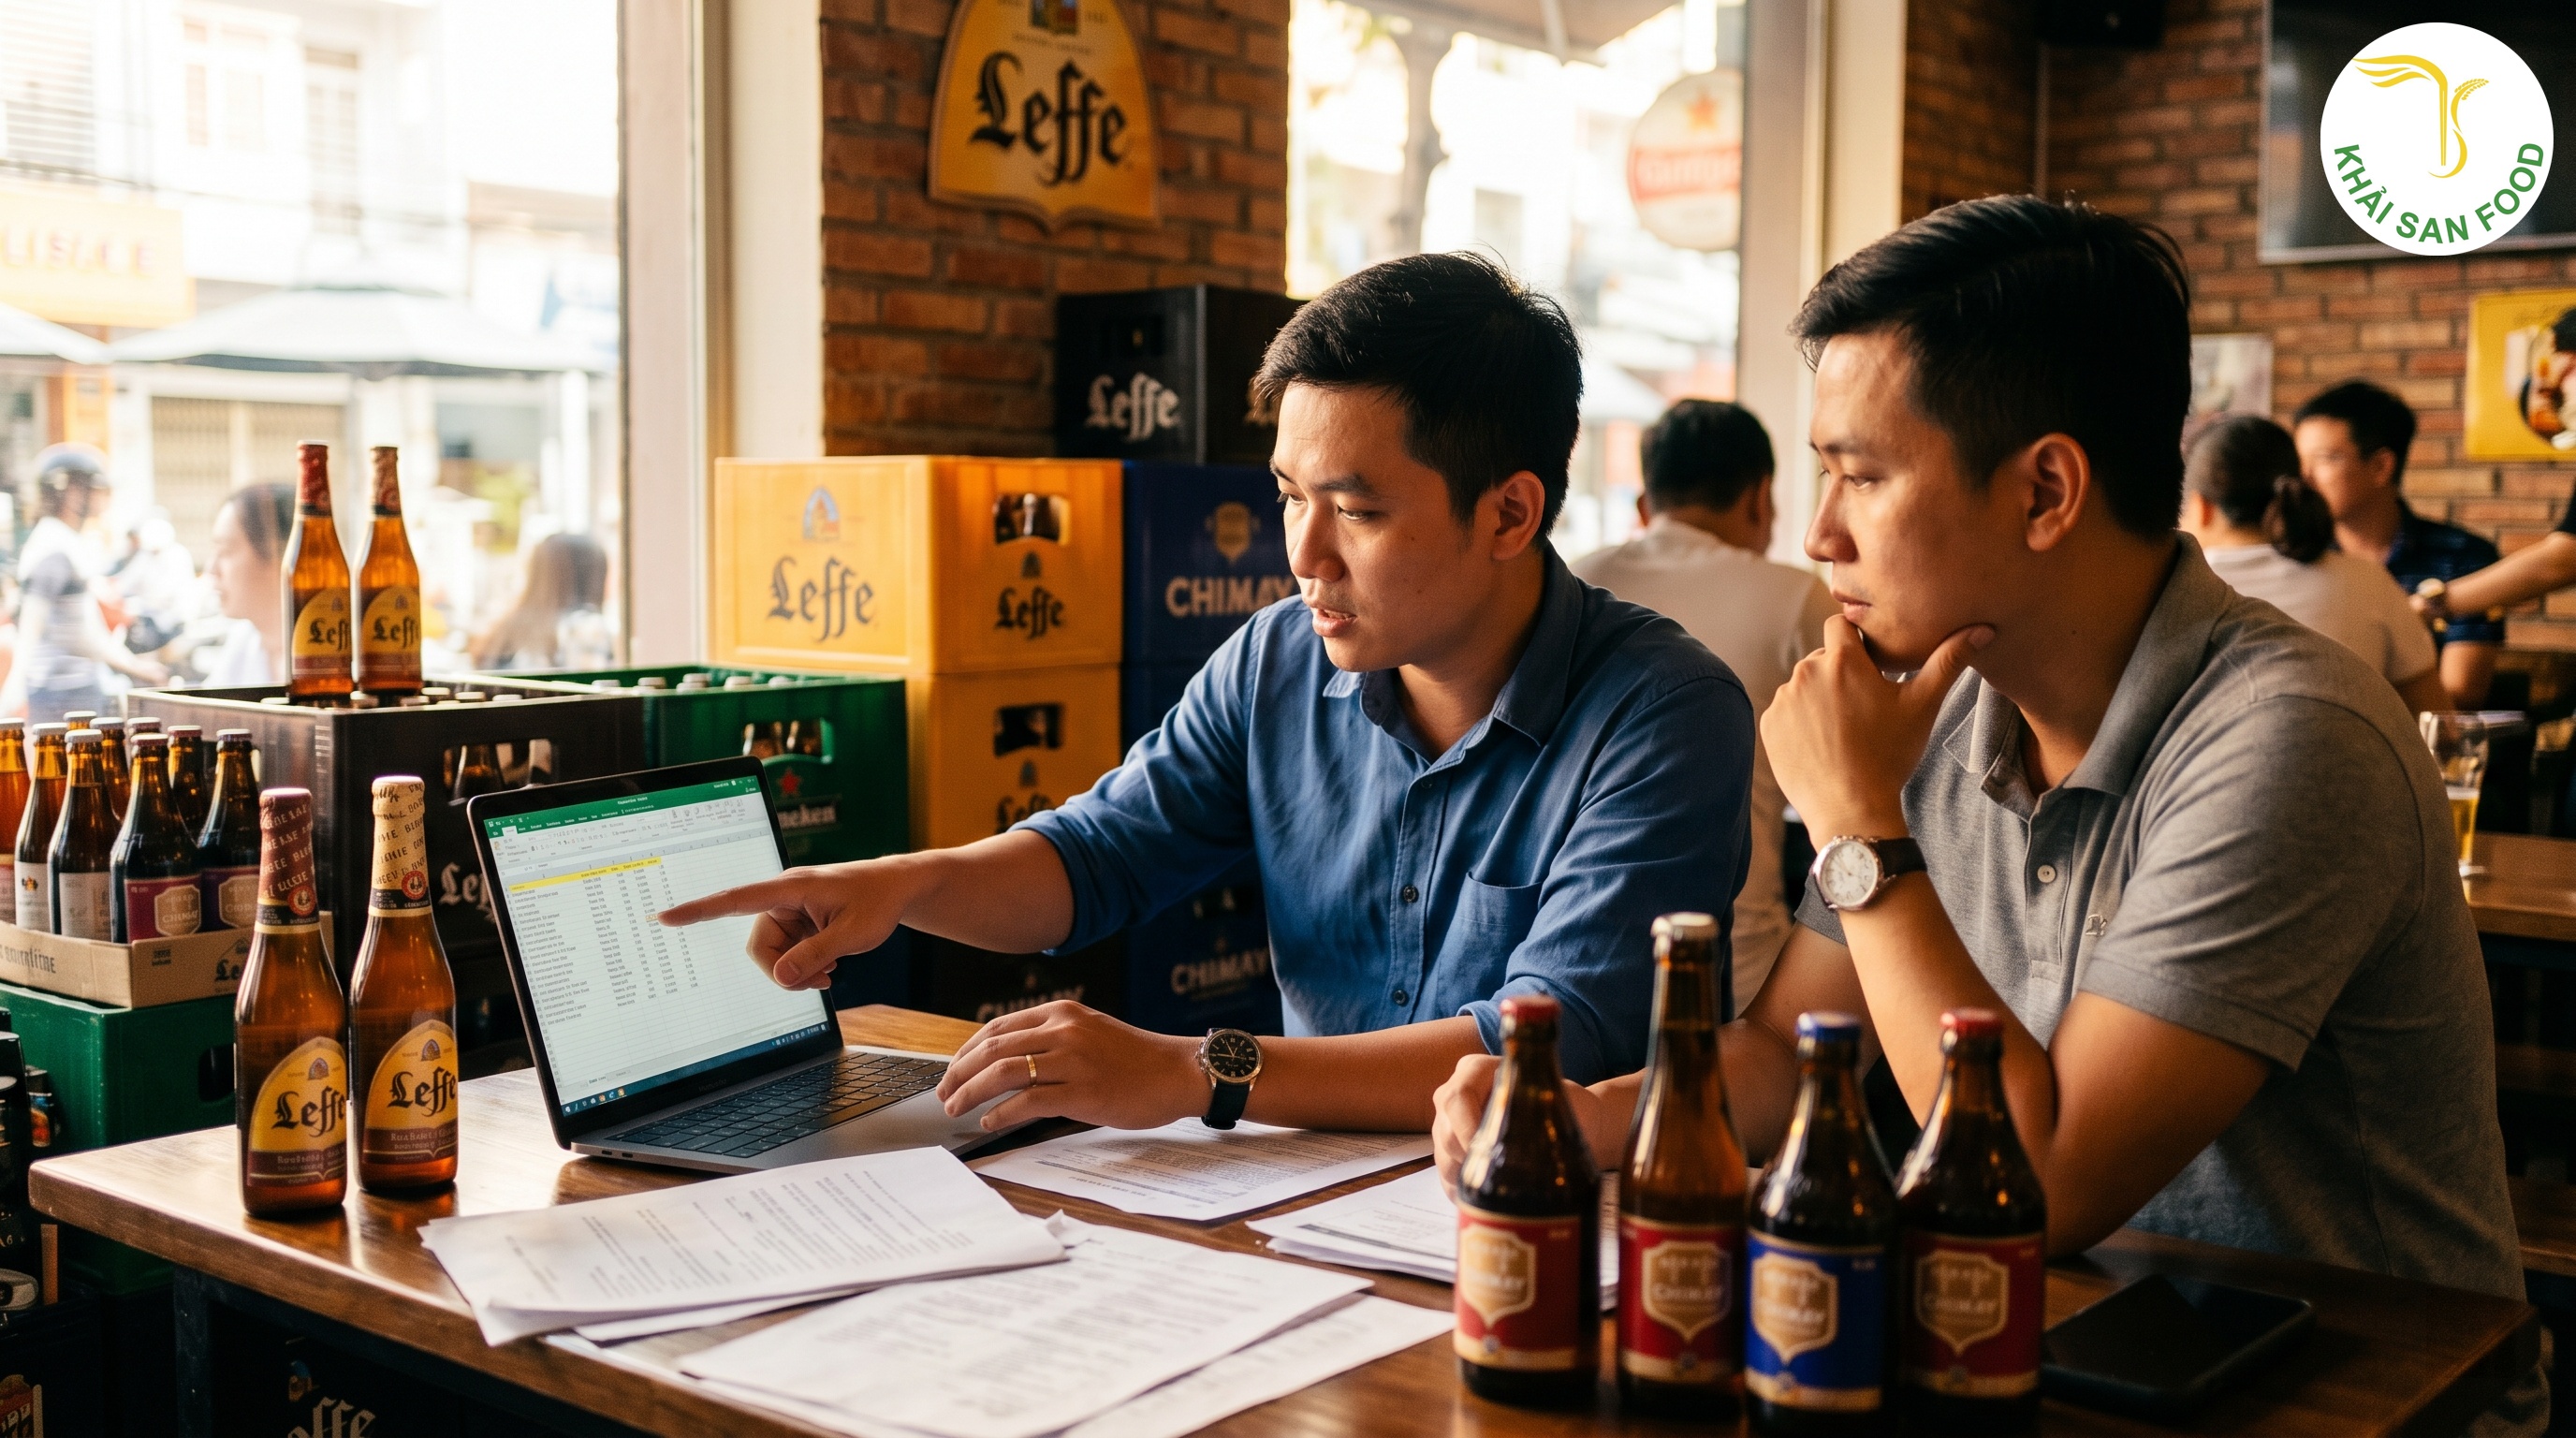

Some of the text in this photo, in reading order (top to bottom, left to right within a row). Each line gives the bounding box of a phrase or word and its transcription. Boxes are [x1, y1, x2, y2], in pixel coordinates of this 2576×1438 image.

[968, 51, 1126, 187] Leffe
[1083, 373, 1181, 443] Leffe
[767, 556, 875, 643] Leffe
[994, 586, 1065, 639] Leffe
[1165, 575, 1294, 618] CHIMAY
[438, 861, 495, 924] Lef
[1170, 947, 1268, 993] CHIMAY
[271, 1085, 345, 1137] Leffe
[387, 1065, 457, 1117] Leffe
